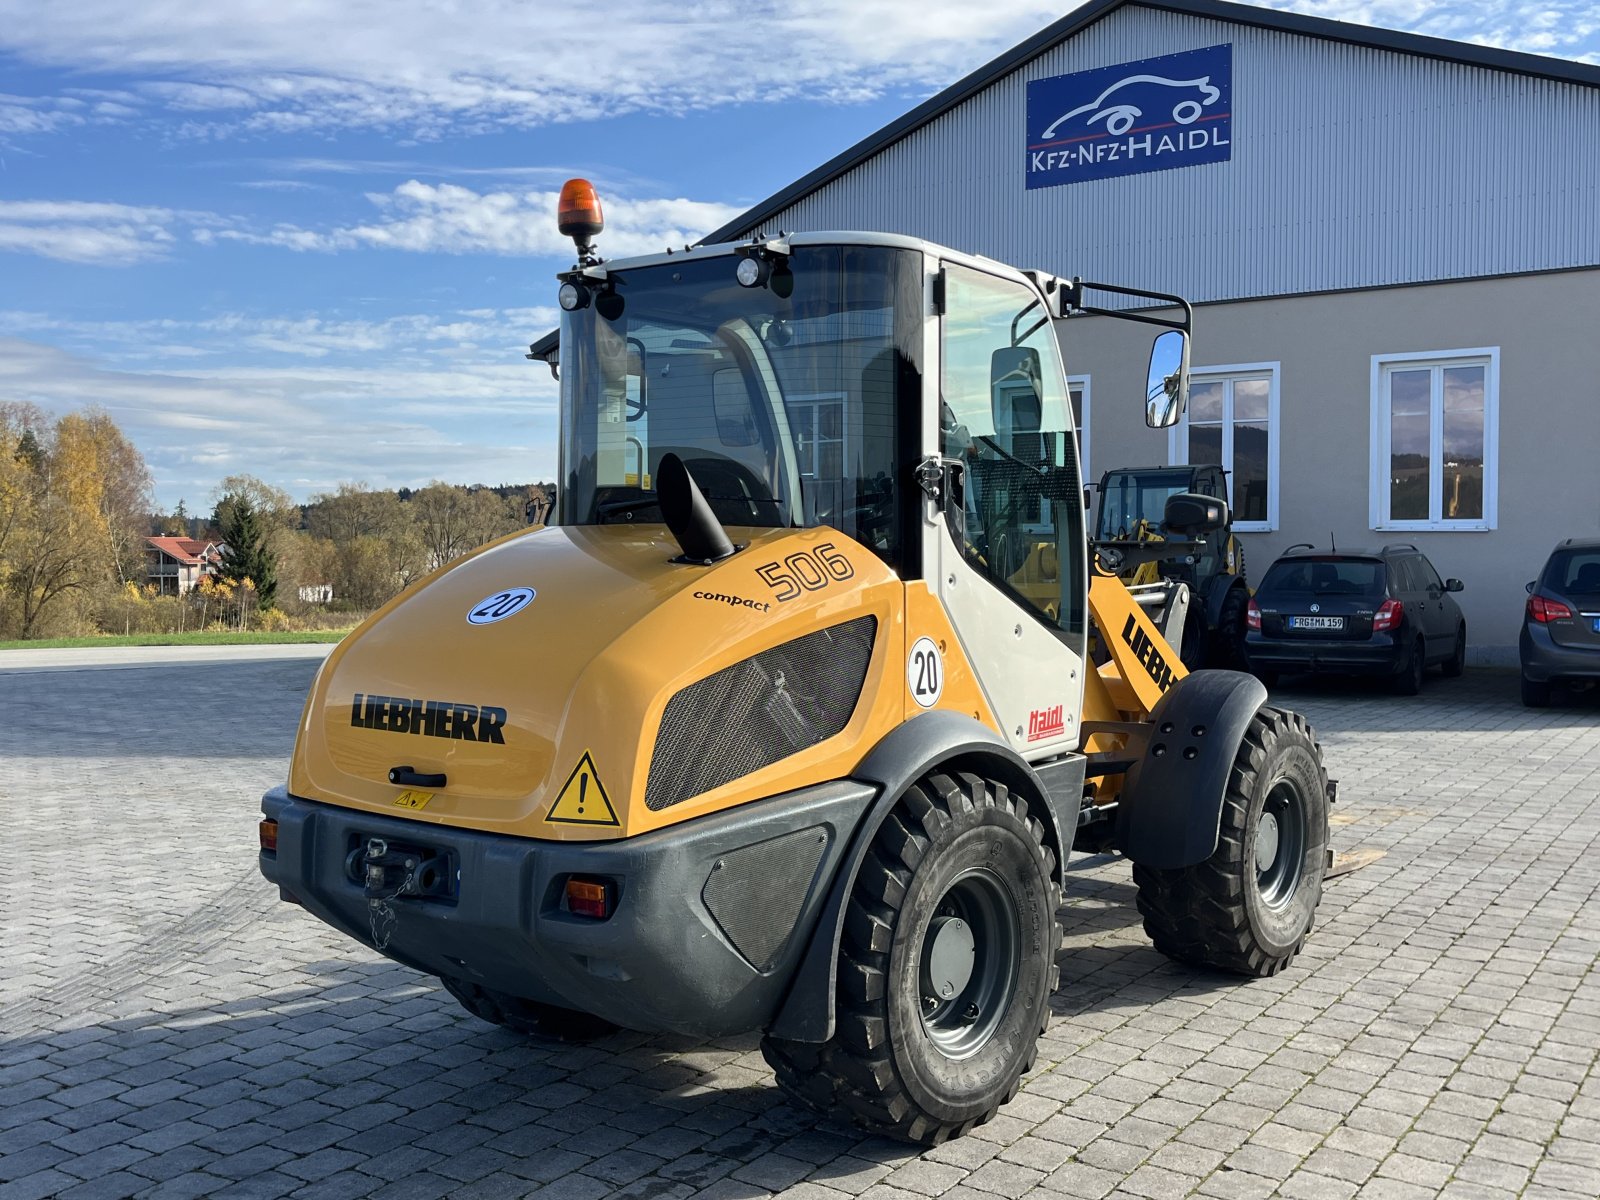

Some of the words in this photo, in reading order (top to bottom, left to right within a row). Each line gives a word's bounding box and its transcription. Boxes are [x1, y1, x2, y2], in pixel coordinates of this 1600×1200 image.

[755, 543, 855, 602] 506
[473, 592, 528, 617] 20
[693, 591, 771, 613] compact
[1327, 617, 1343, 628] 159
[914, 651, 938, 695] 20
[1121, 612, 1179, 694] LIEBH
[351, 693, 507, 745] LIEBHERR
